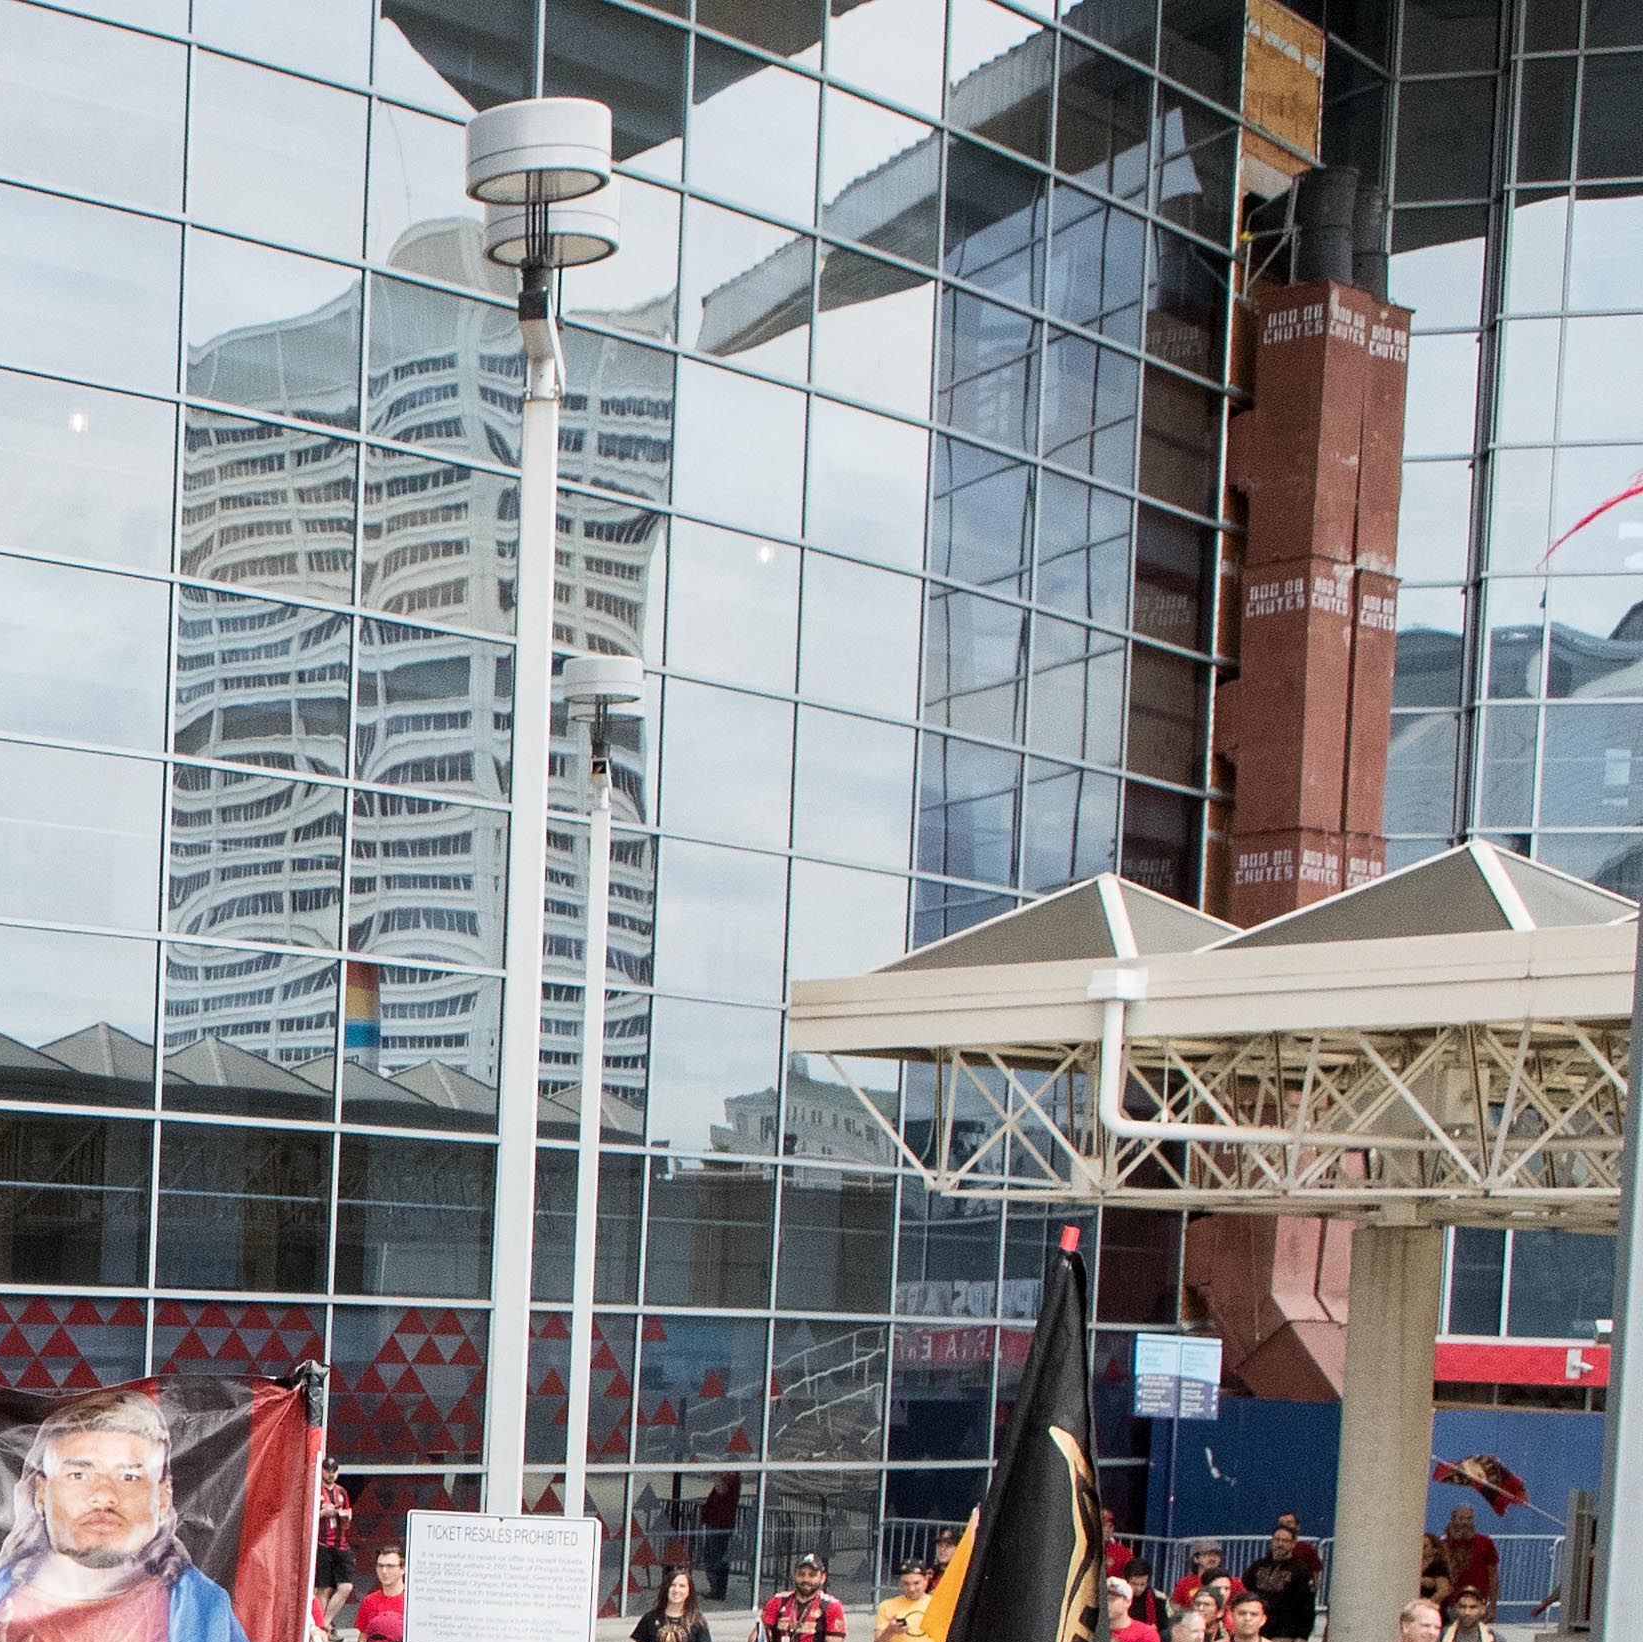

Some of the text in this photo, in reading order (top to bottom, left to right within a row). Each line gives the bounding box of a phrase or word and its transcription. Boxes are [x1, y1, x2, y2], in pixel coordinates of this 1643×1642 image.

[427, 1524, 578, 1547] TICKET RESALES PROHIBITED
